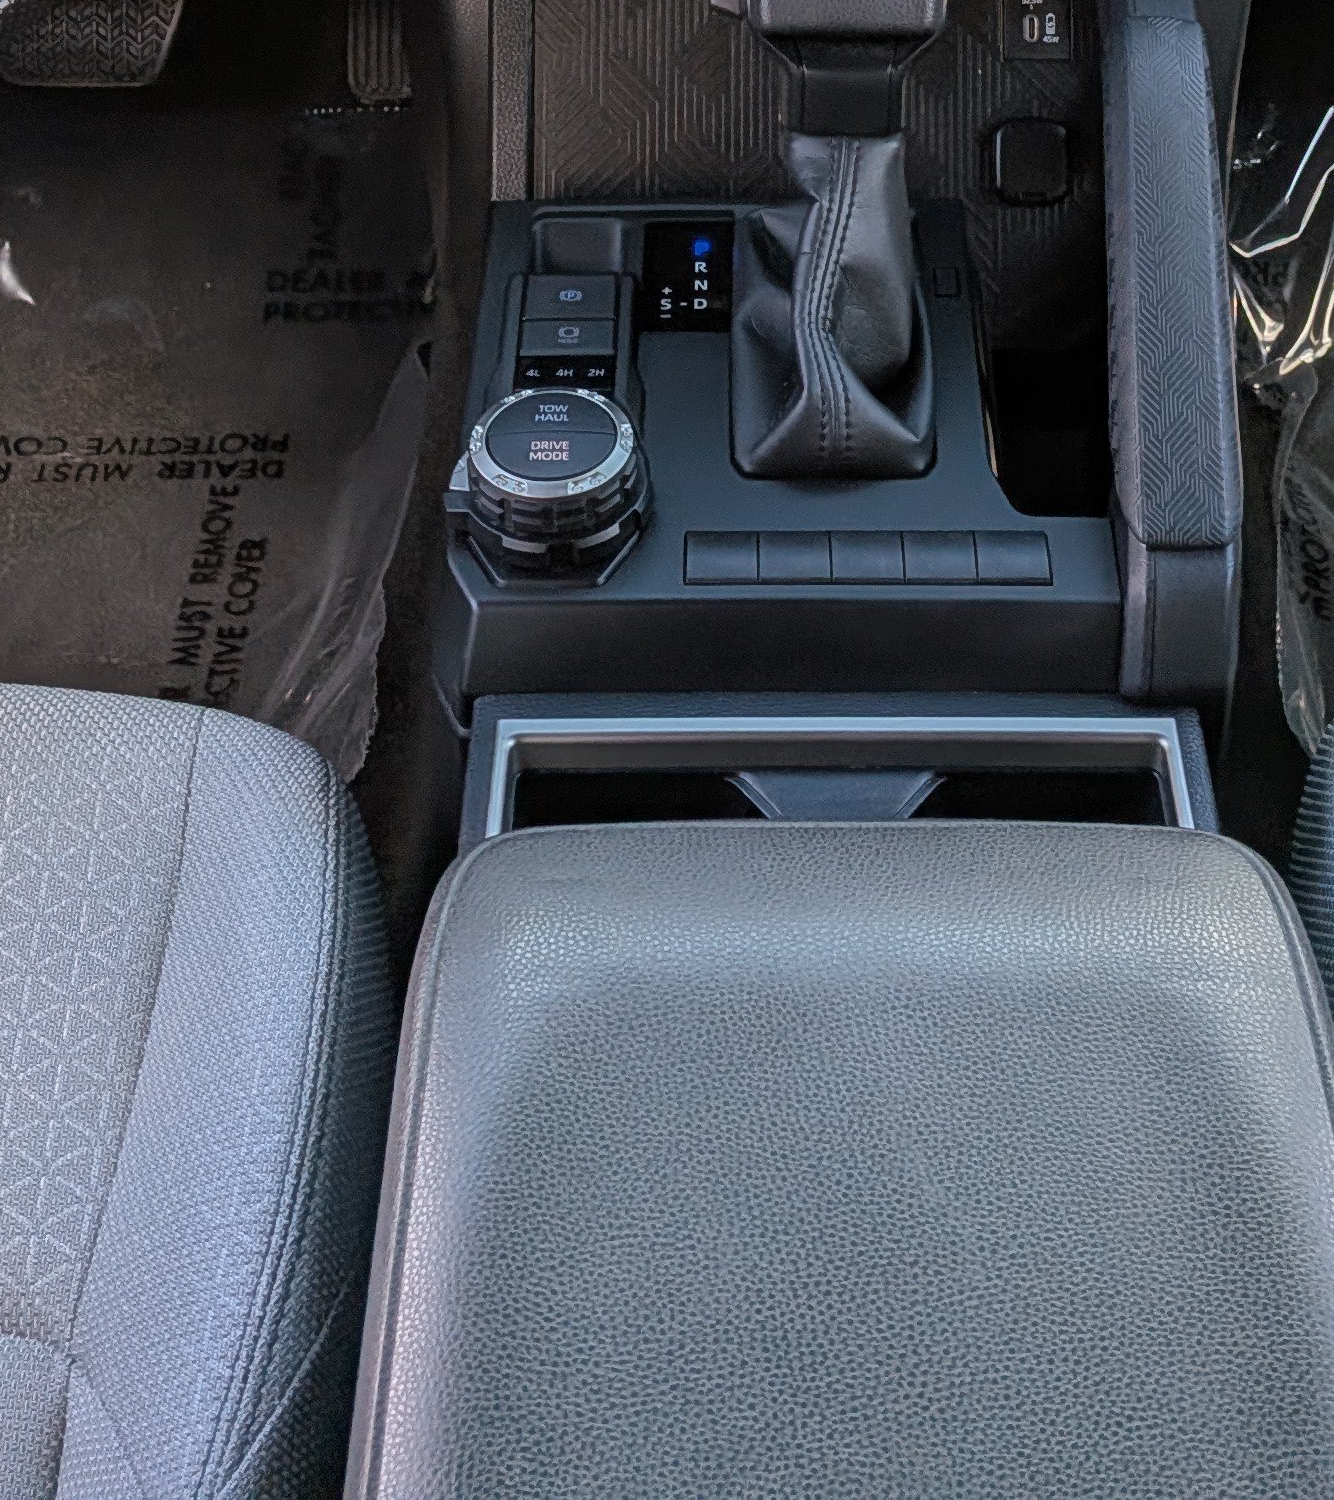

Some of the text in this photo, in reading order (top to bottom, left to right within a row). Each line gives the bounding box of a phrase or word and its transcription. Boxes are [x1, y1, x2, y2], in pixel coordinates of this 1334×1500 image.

[693, 238, 711, 256] P
[694, 261, 708, 273] R
[694, 279, 708, 291] N
[660, 298, 708, 310] S D
[525, 368, 541, 377] 4L
[555, 368, 574, 378] 4H
[587, 368, 605, 377] 2H
[539, 404, 569, 413] TOW
[534, 412, 570, 422] HAUL
[85, 432, 291, 458] PROTECTIVE
[530, 440, 570, 450] DRIVE
[529, 451, 570, 461] MODE
[31, 460, 133, 483] MUST
[158, 458, 285, 481] DEALER
[187, 483, 240, 585] REMOVE
[224, 537, 267, 618] COVER
[168, 597, 214, 668] MUST
